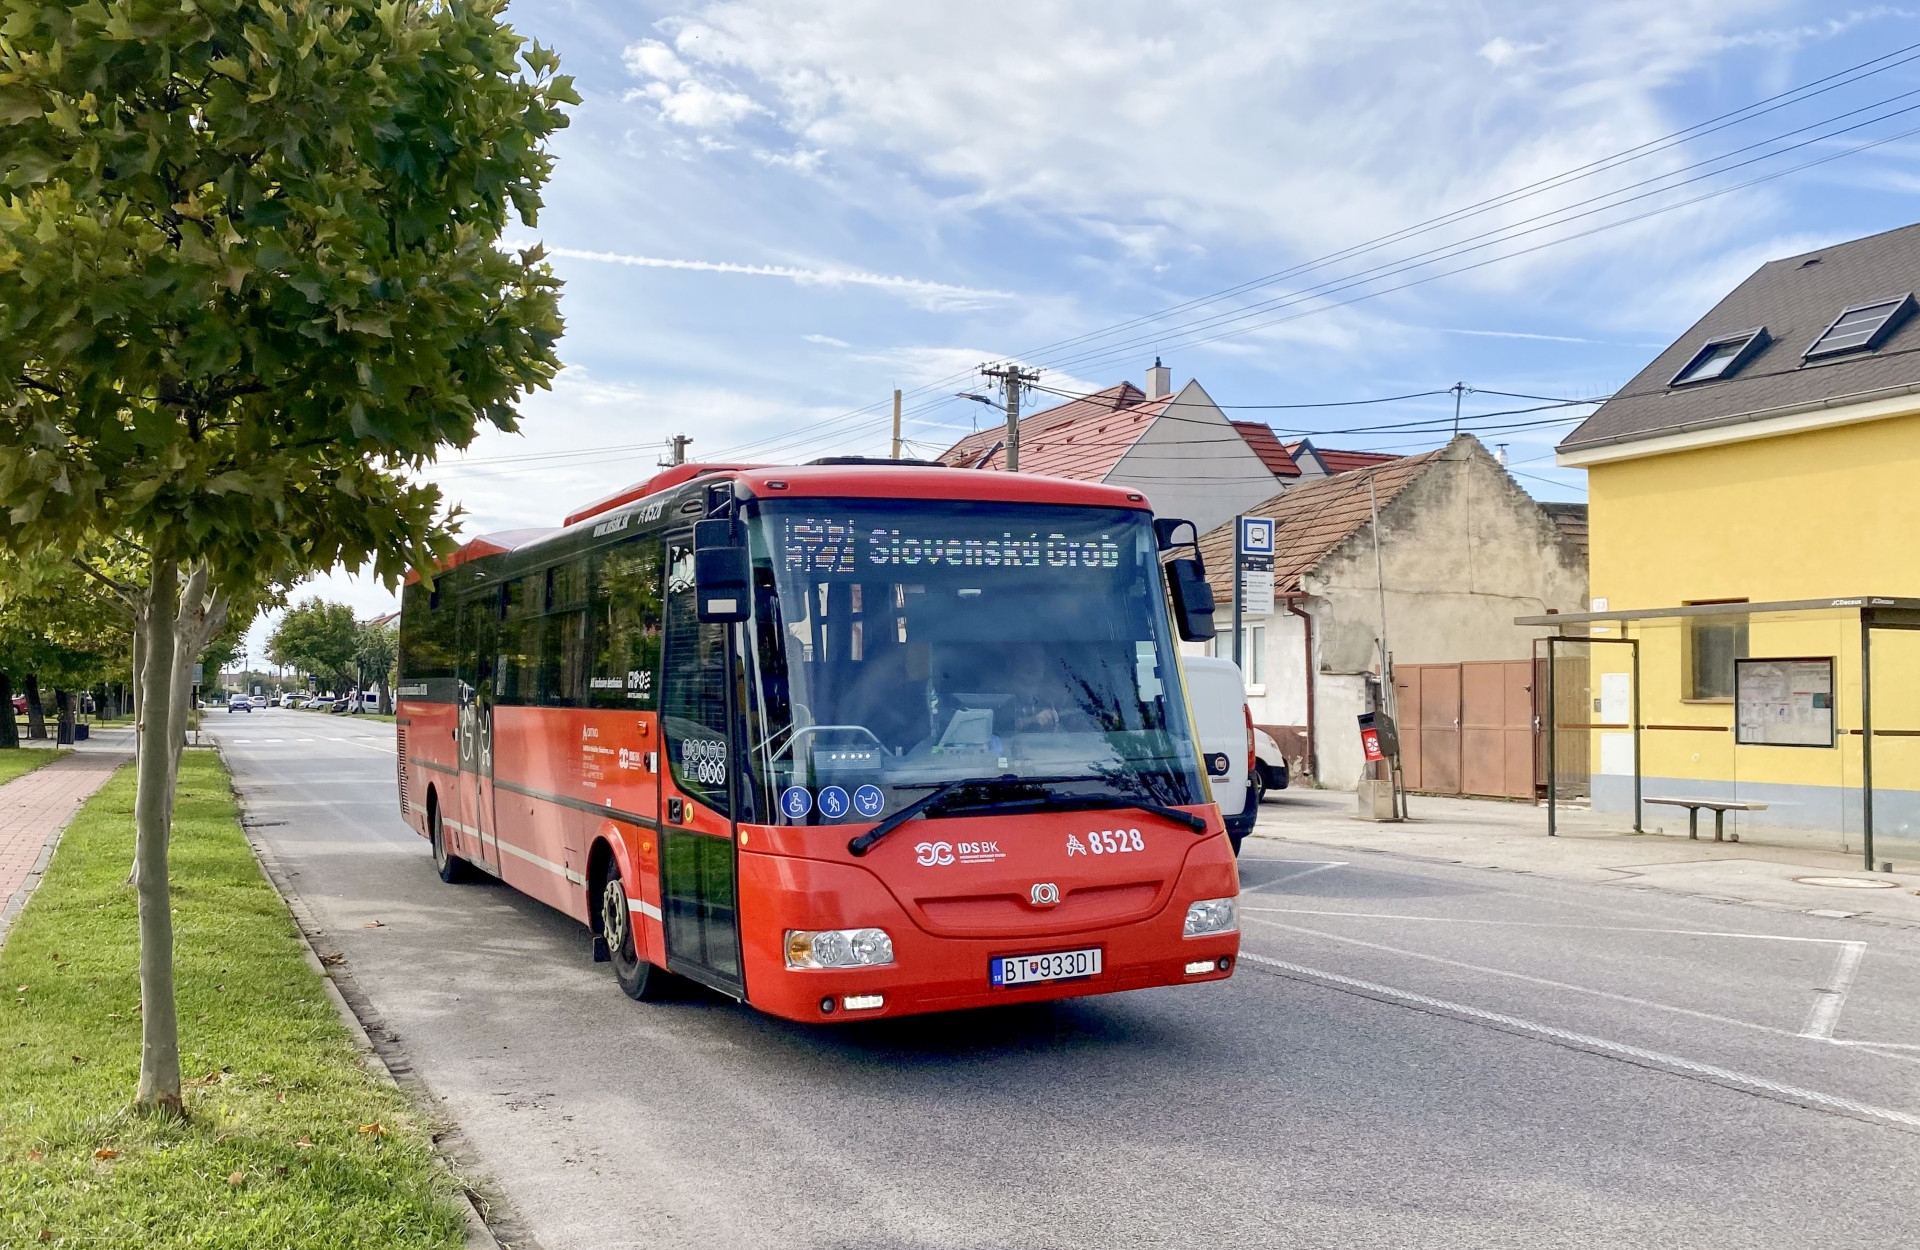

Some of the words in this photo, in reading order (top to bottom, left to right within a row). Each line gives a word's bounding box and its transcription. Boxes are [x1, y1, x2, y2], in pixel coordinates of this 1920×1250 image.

[869, 529, 1040, 566] Slovenský
[1047, 533, 1118, 567] Grob
[957, 842, 980, 854] IDS
[981, 840, 1000, 853] BK
[1088, 828, 1145, 855] 8528
[1005, 959, 1029, 982] BT
[1040, 951, 1096, 977] 933DI
